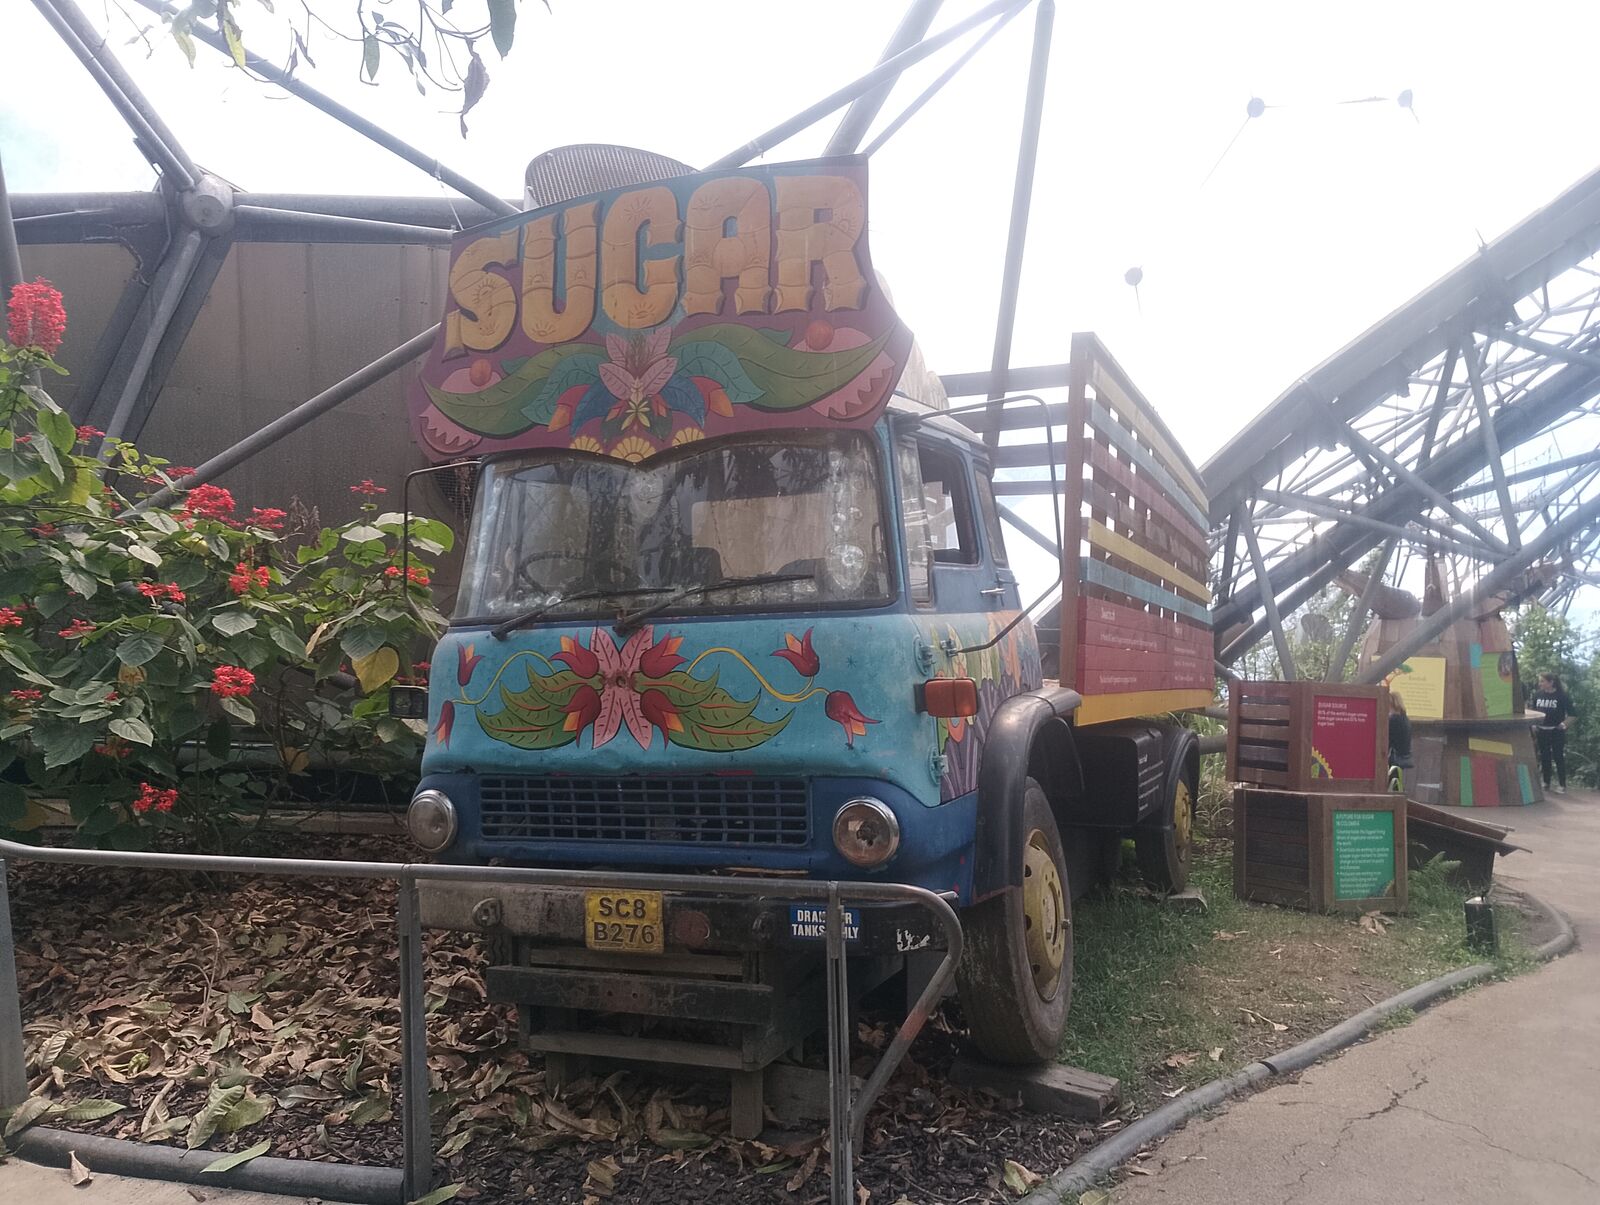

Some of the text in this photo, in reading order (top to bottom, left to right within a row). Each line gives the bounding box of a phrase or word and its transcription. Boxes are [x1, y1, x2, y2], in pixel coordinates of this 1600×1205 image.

[443, 175, 868, 358] SUGAR
[1536, 698, 1558, 709] PARIS
[599, 897, 646, 918] SC8
[594, 921, 655, 944] B276
[792, 923, 826, 937] TANKS
